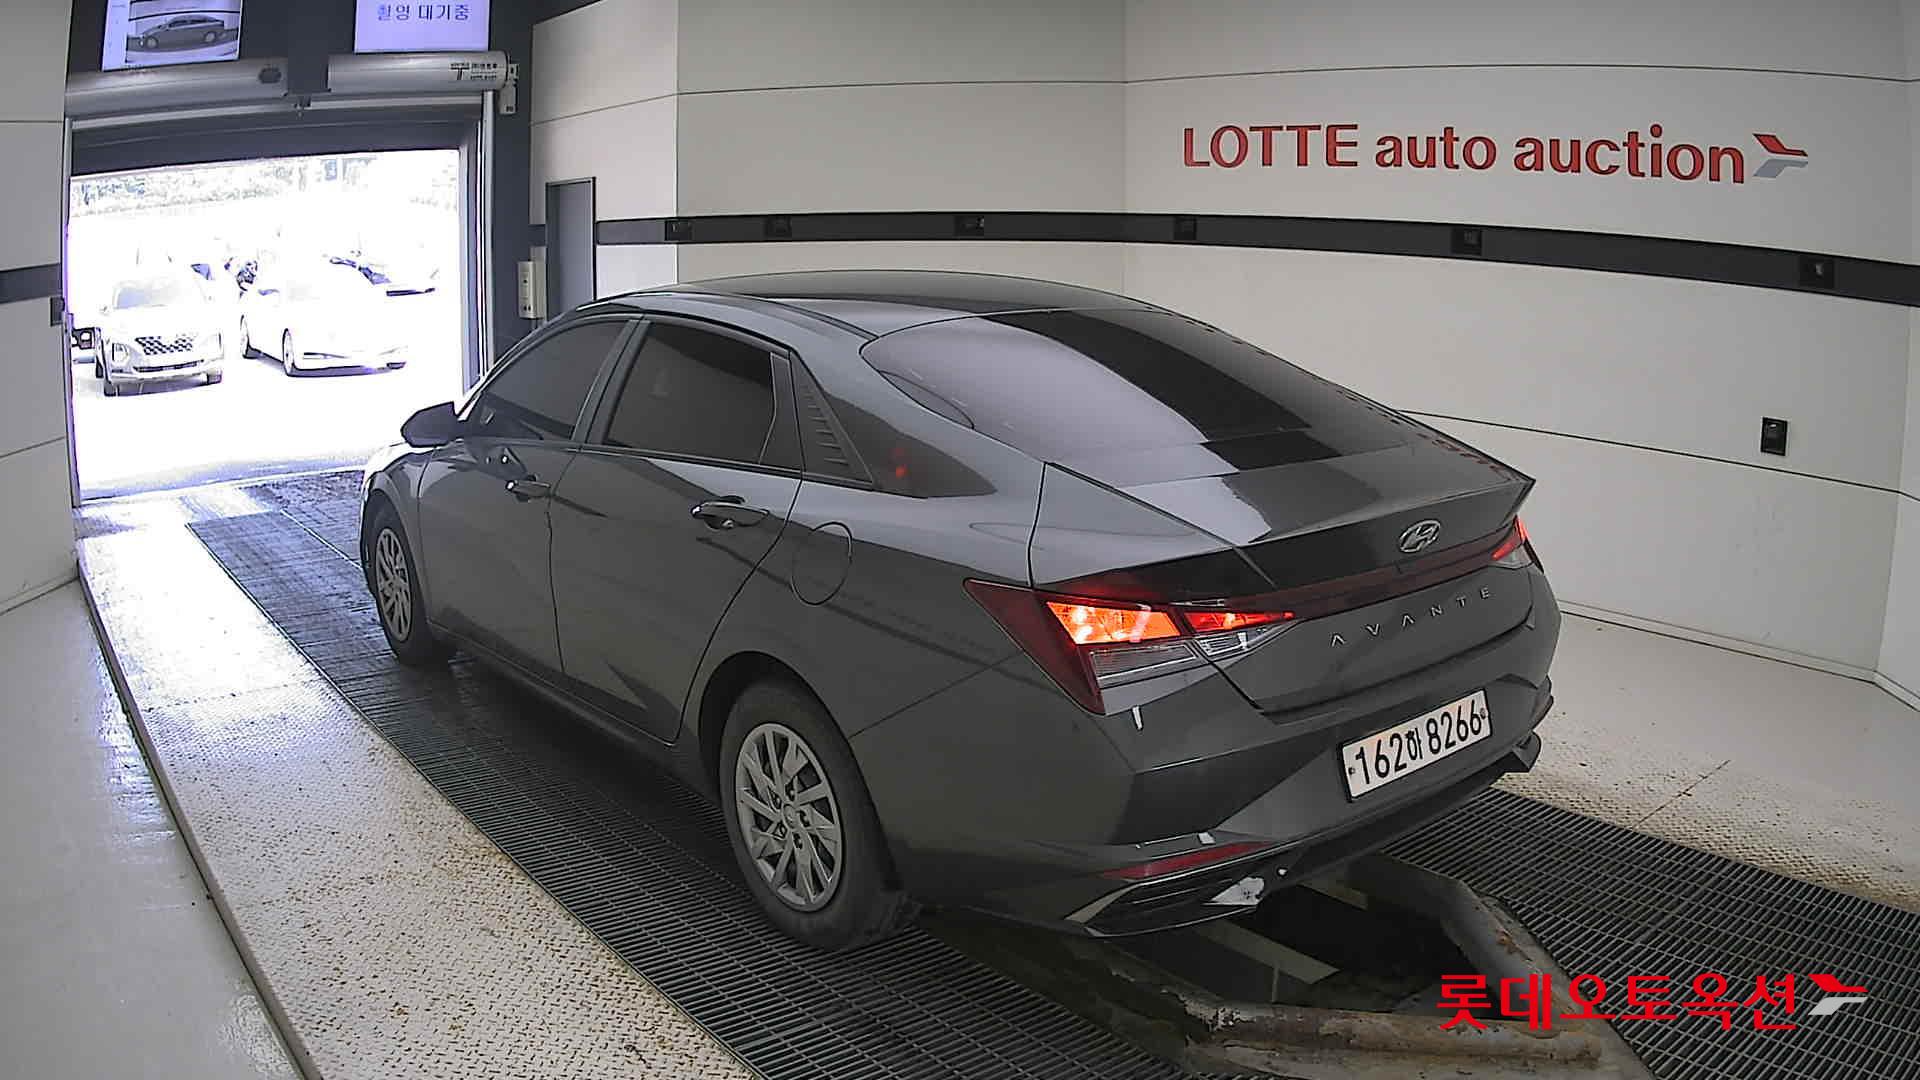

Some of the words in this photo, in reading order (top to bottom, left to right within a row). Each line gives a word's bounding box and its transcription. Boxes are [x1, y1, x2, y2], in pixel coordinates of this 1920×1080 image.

[418, 4, 471, 21] 대기중
[1184, 124, 1358, 168] LOTTE
[1375, 126, 1497, 170] auto
[1514, 124, 1745, 183] auction
[1331, 587, 1490, 647] AVANTE
[1426, 699, 1482, 755] 8266
